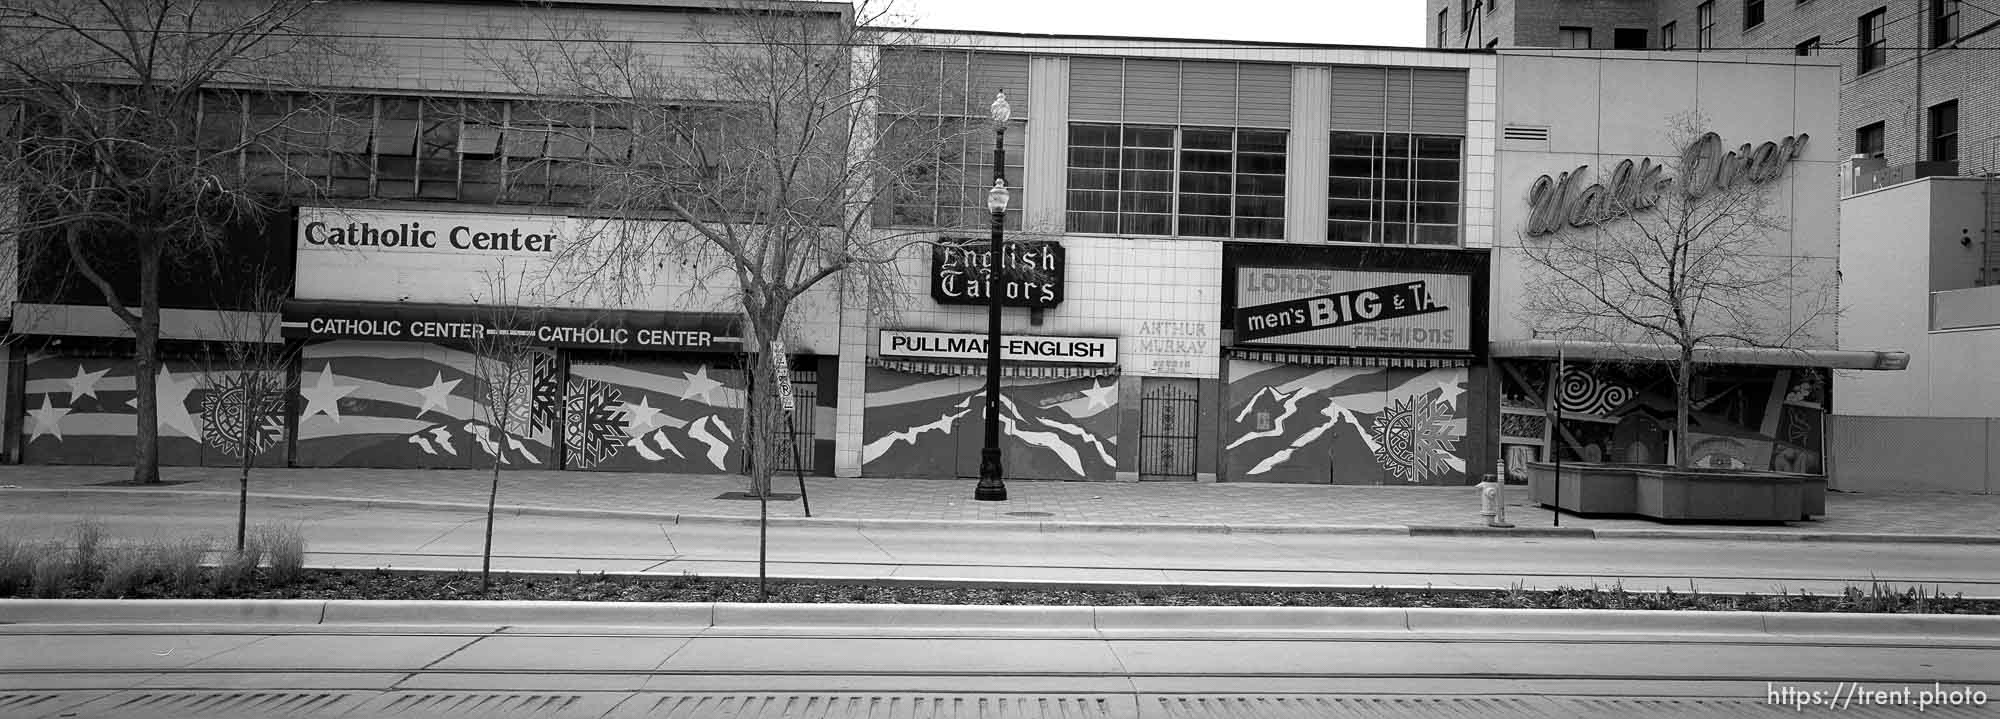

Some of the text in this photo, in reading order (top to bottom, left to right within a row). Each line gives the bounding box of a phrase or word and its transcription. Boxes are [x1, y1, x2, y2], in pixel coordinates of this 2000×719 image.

[304, 221, 558, 252] Catholic Center
[940, 269, 1055, 303] Taiors
[1247, 271, 1332, 293] LORD'S
[1248, 307, 1306, 331] men's
[1308, 291, 1383, 327] BIG
[1393, 294, 1405, 310] &
[310, 318, 485, 339] CATHOLIC CENTER
[538, 326, 711, 346] CATHOLIC CENTER
